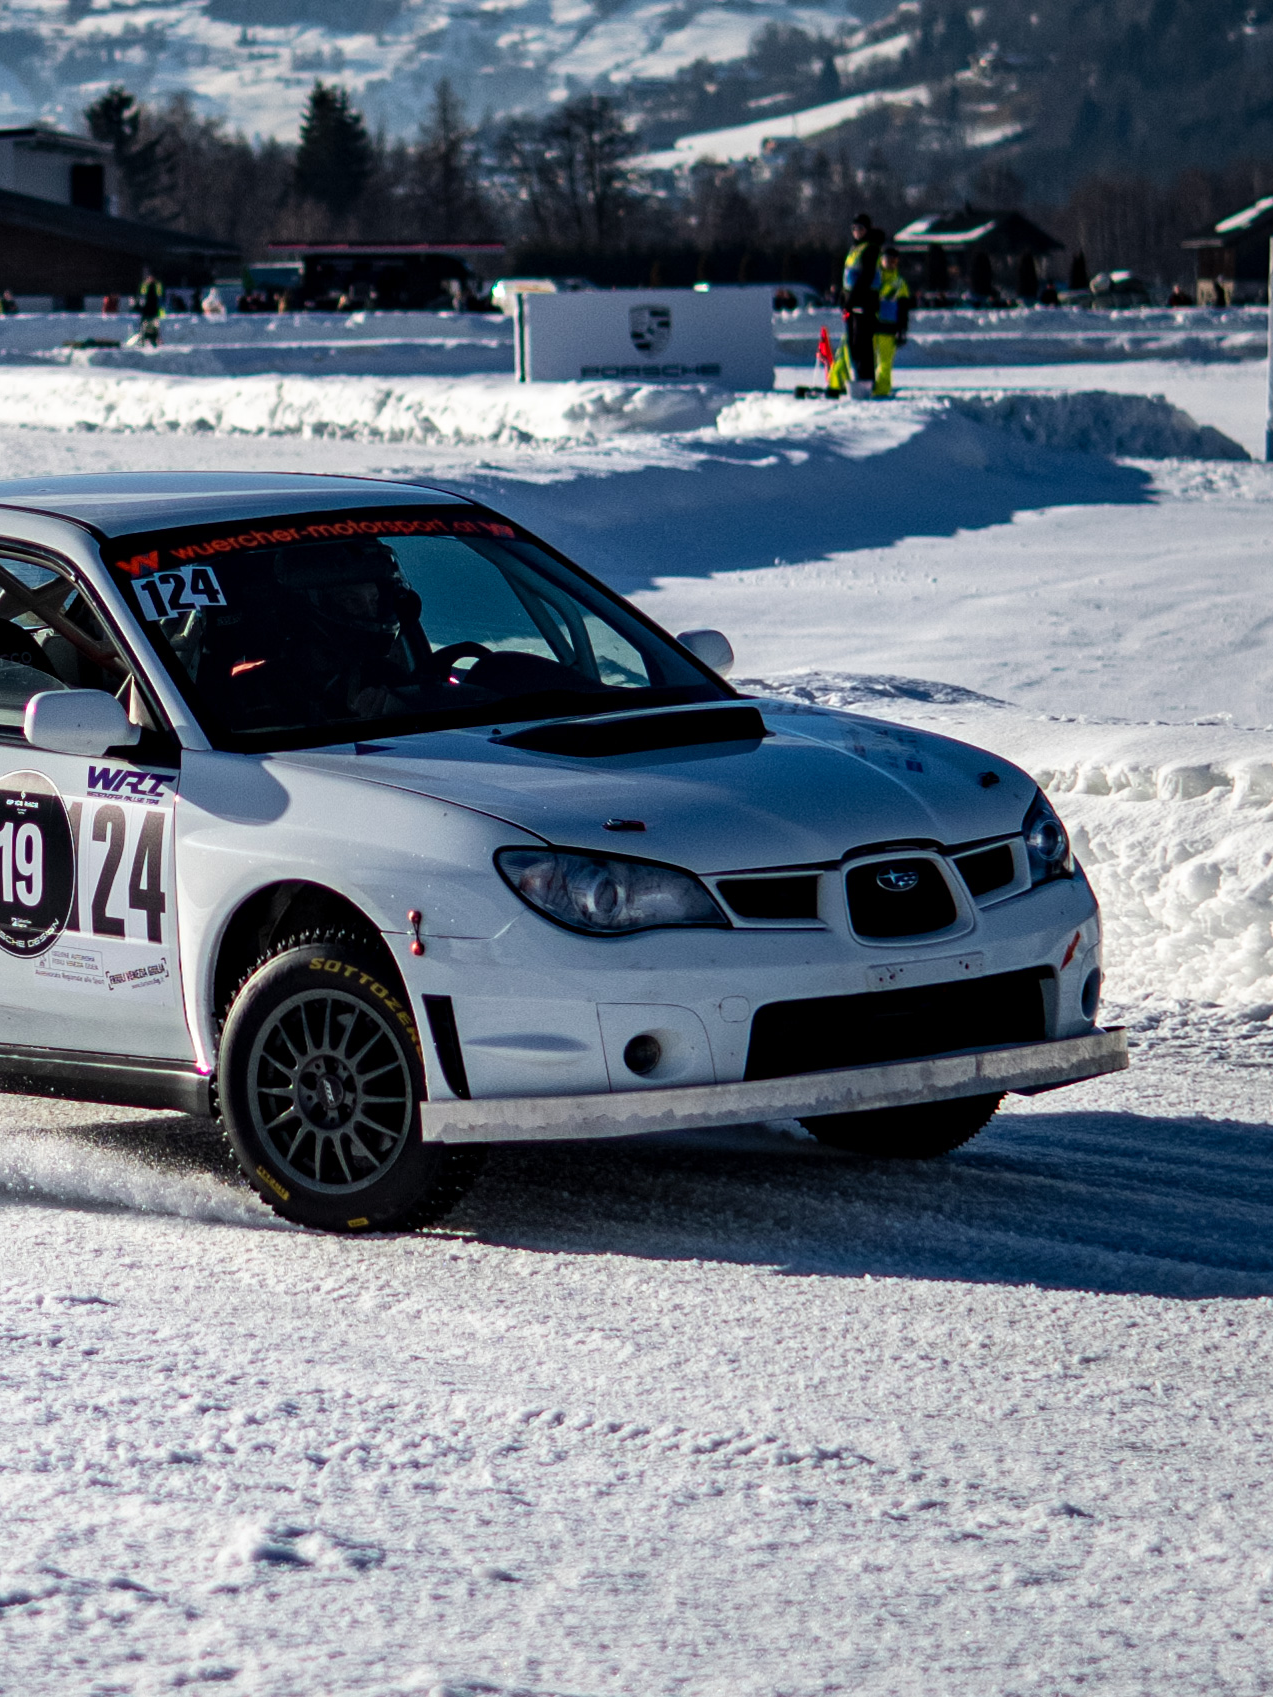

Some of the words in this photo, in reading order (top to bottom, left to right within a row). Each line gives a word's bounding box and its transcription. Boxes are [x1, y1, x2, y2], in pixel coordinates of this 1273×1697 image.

[581, 364, 721, 378] PORSCHE
[170, 518, 480, 561] wuercher-motorsport.at
[141, 567, 222, 619] 124
